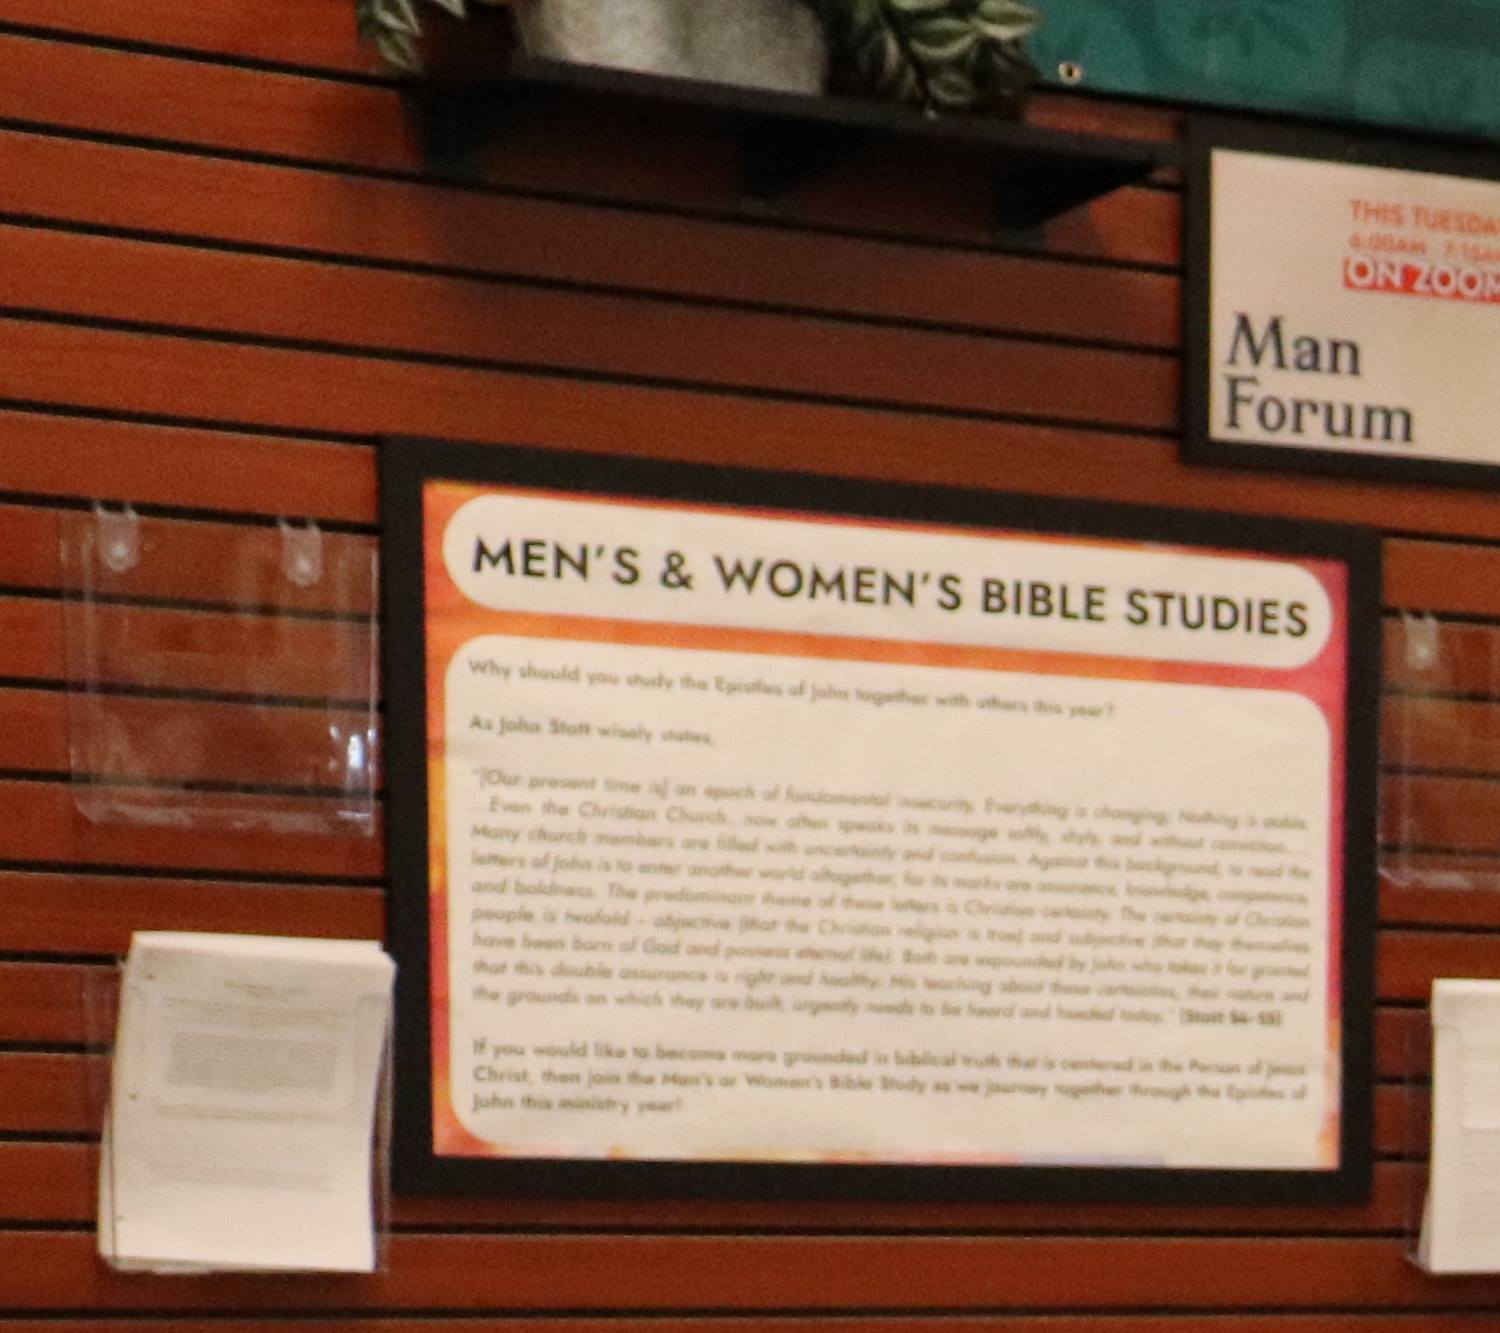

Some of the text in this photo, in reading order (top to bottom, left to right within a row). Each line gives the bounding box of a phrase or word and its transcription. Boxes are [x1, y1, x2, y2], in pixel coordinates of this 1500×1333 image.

[1349, 198, 1403, 226] THIS
[1348, 256, 1400, 289] ON
[1227, 311, 1362, 377] Man
[1224, 373, 1413, 443] Forum
[472, 536, 1310, 638] MEN'S & WOMEN'S BIBLE STUDIES
[469, 714, 493, 732] As
[498, 716, 542, 738] John
[548, 719, 592, 738] Stott
